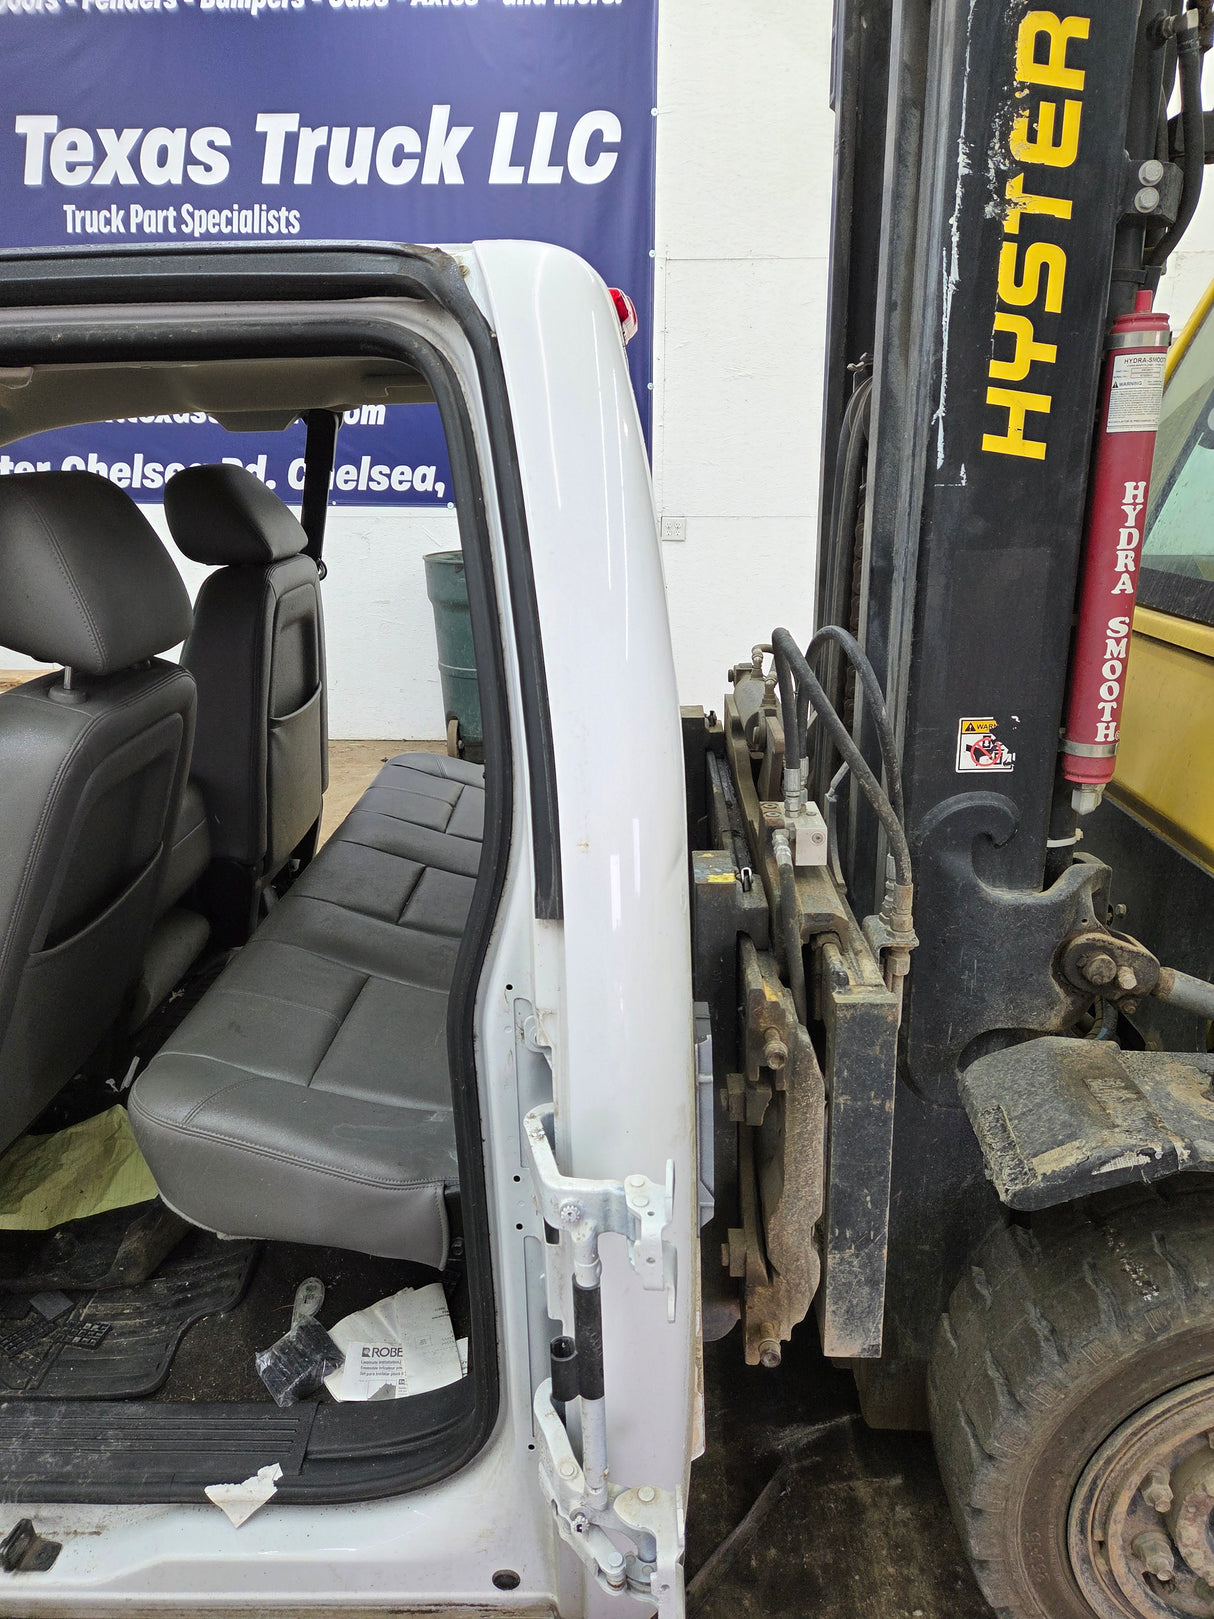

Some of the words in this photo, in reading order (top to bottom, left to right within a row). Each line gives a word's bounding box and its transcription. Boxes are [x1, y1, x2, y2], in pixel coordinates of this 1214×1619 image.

[15, 114, 231, 186] Texas
[255, 104, 474, 185] Truck
[488, 110, 622, 185] LLC
[63, 204, 125, 233] Truck
[130, 204, 176, 233] Part
[181, 203, 300, 237] Specialists
[982, 11, 1091, 460] HYSTER
[222, 454, 276, 490] d.
[287, 456, 445, 497] Celsea,
[1111, 481, 1147, 594] HYDRA
[1094, 616, 1130, 741] SMOOTH
[372, 1347, 403, 1357] ROBE
